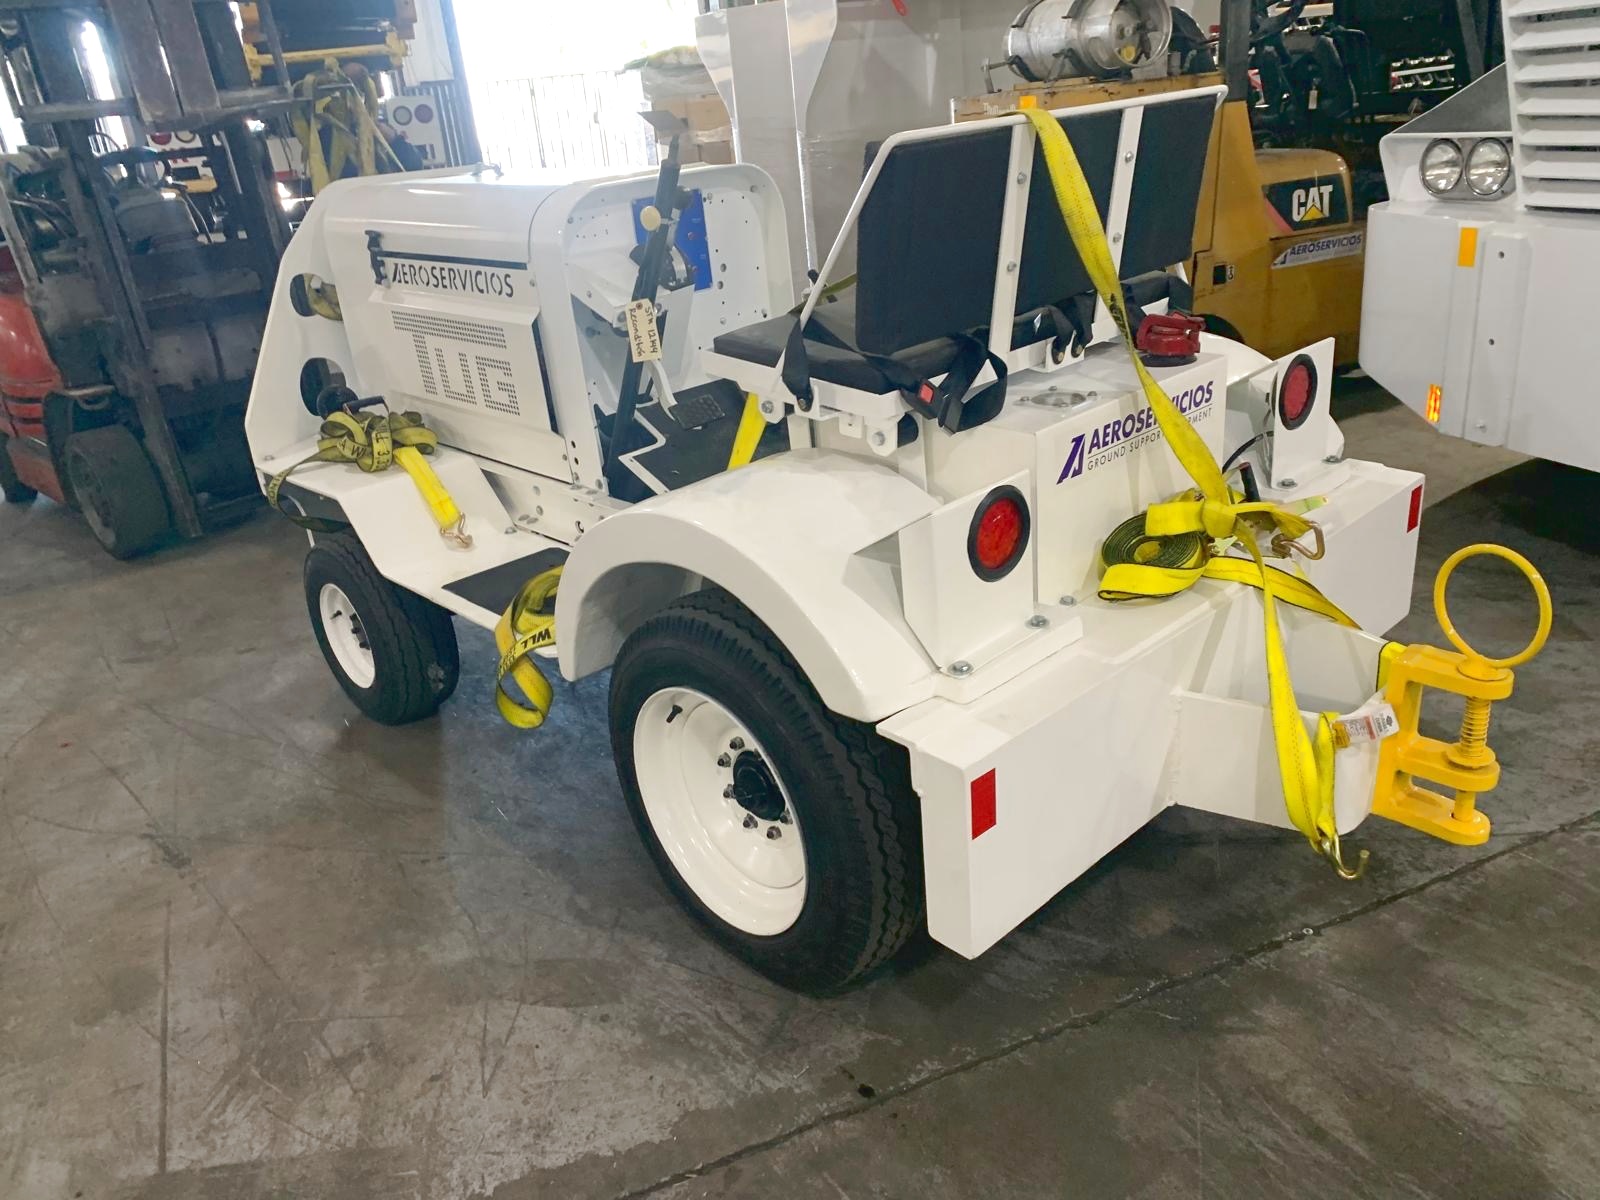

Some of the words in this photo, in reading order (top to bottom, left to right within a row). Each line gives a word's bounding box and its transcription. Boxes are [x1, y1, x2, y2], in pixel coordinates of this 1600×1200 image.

[1292, 184, 1333, 222] CAT
[1289, 234, 1362, 256] AEROSERVICIOS
[392, 263, 514, 298] AEROSERVICIOS
[1088, 446, 1126, 471] GROUND
[1129, 429, 1163, 453] SUPPOR
[520, 628, 552, 650] WLL
